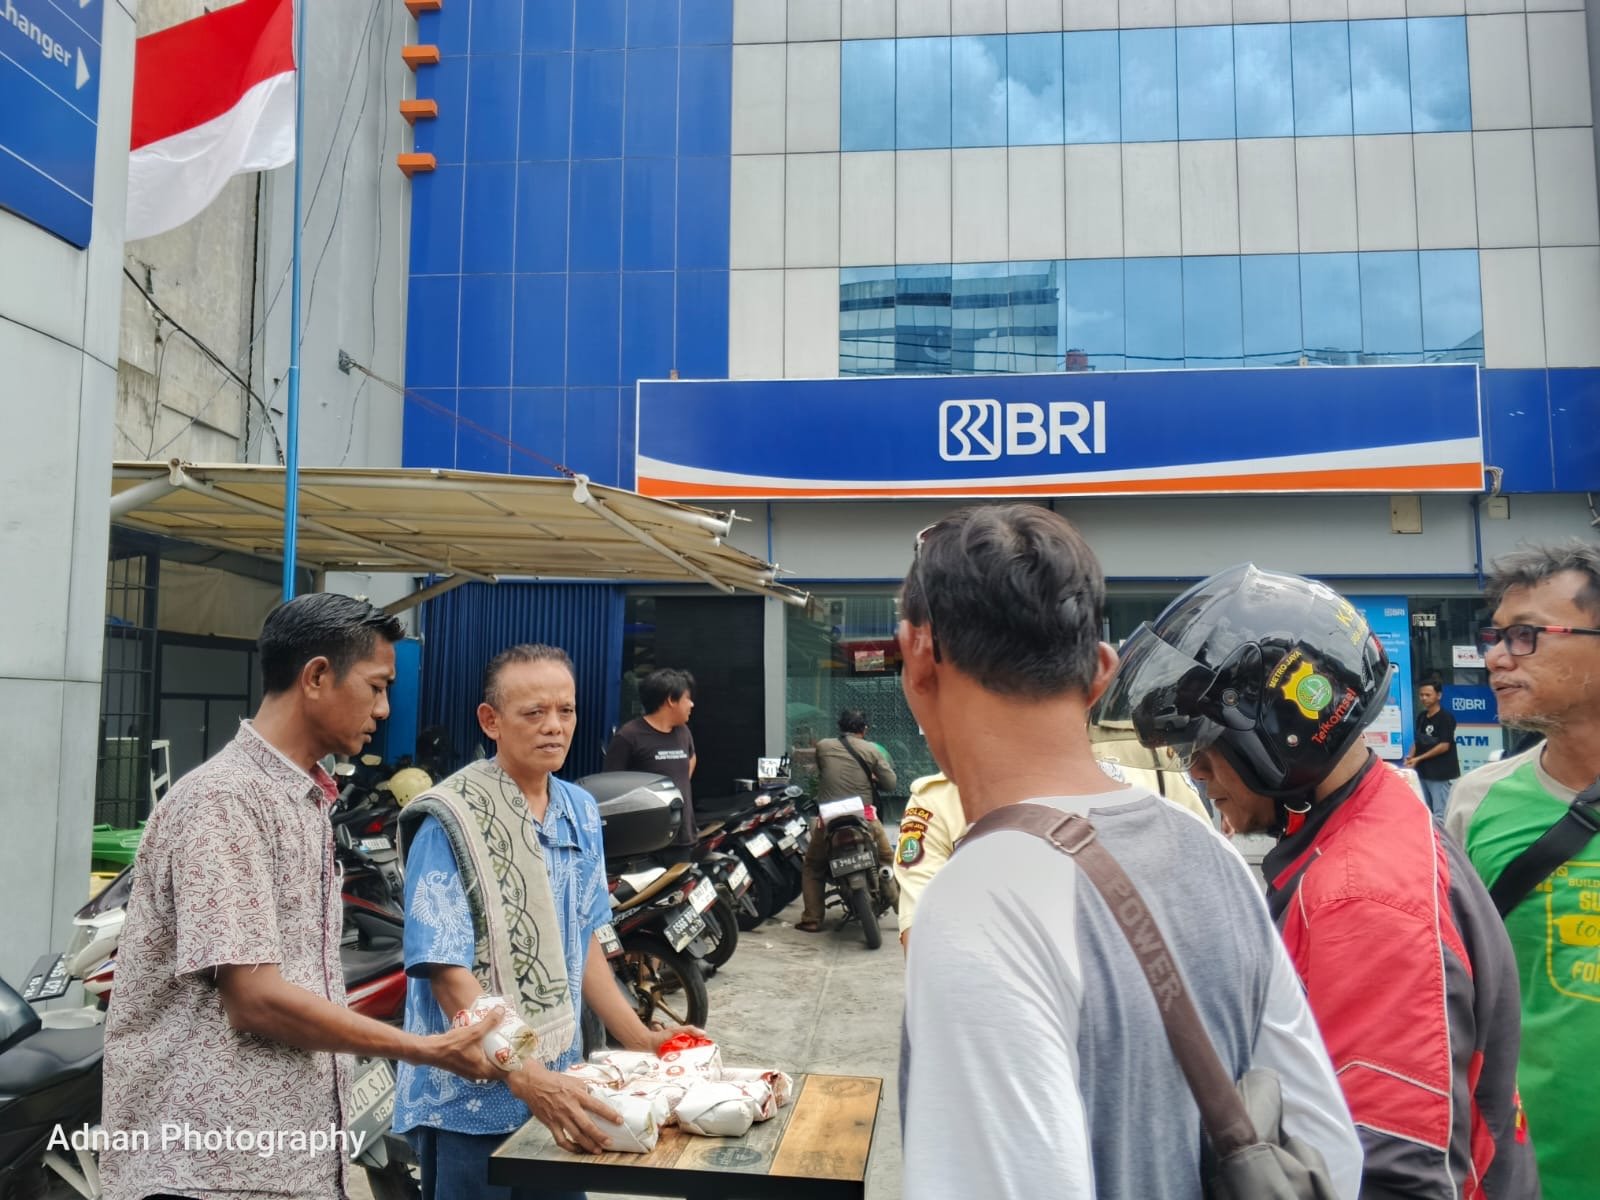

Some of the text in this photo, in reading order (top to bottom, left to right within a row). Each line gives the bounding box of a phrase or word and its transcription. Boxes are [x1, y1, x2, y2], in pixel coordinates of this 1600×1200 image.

[0, 0, 72, 67] hanger
[1006, 401, 1106, 456] BRI
[1268, 650, 1303, 689] METRO JAYA
[1311, 687, 1357, 744] Telkomsel
[1466, 698, 1486, 710] BRI
[1455, 735, 1489, 747] ATM
[1099, 871, 1181, 1013] POWER
